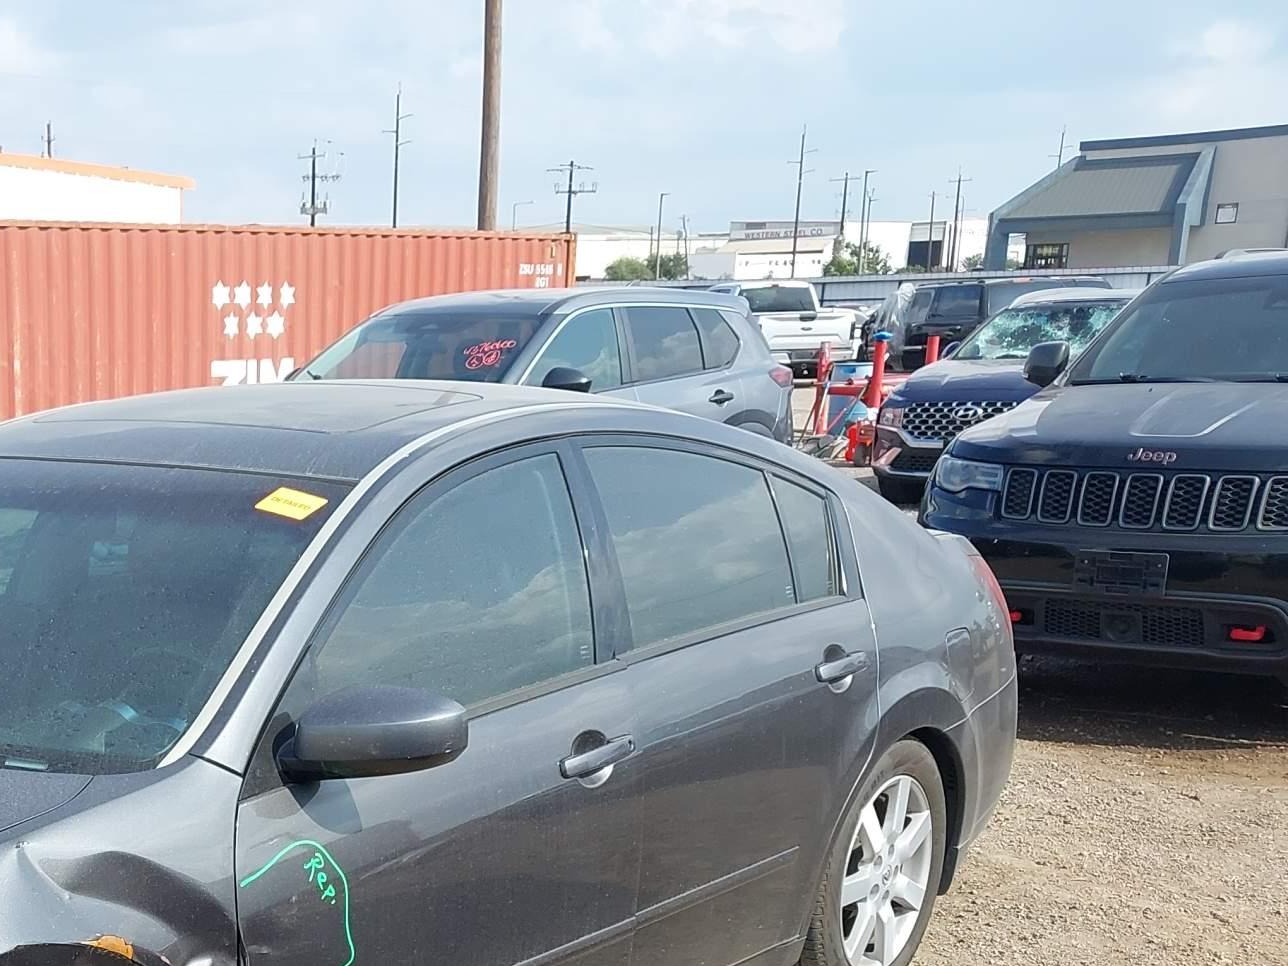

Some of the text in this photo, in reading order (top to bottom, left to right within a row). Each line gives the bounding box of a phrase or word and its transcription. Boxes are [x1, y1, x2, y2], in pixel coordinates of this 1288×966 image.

[745, 231, 781, 240] WESTERN
[784, 227, 806, 237] STEL
[1128, 447, 1177, 465] Jeep
